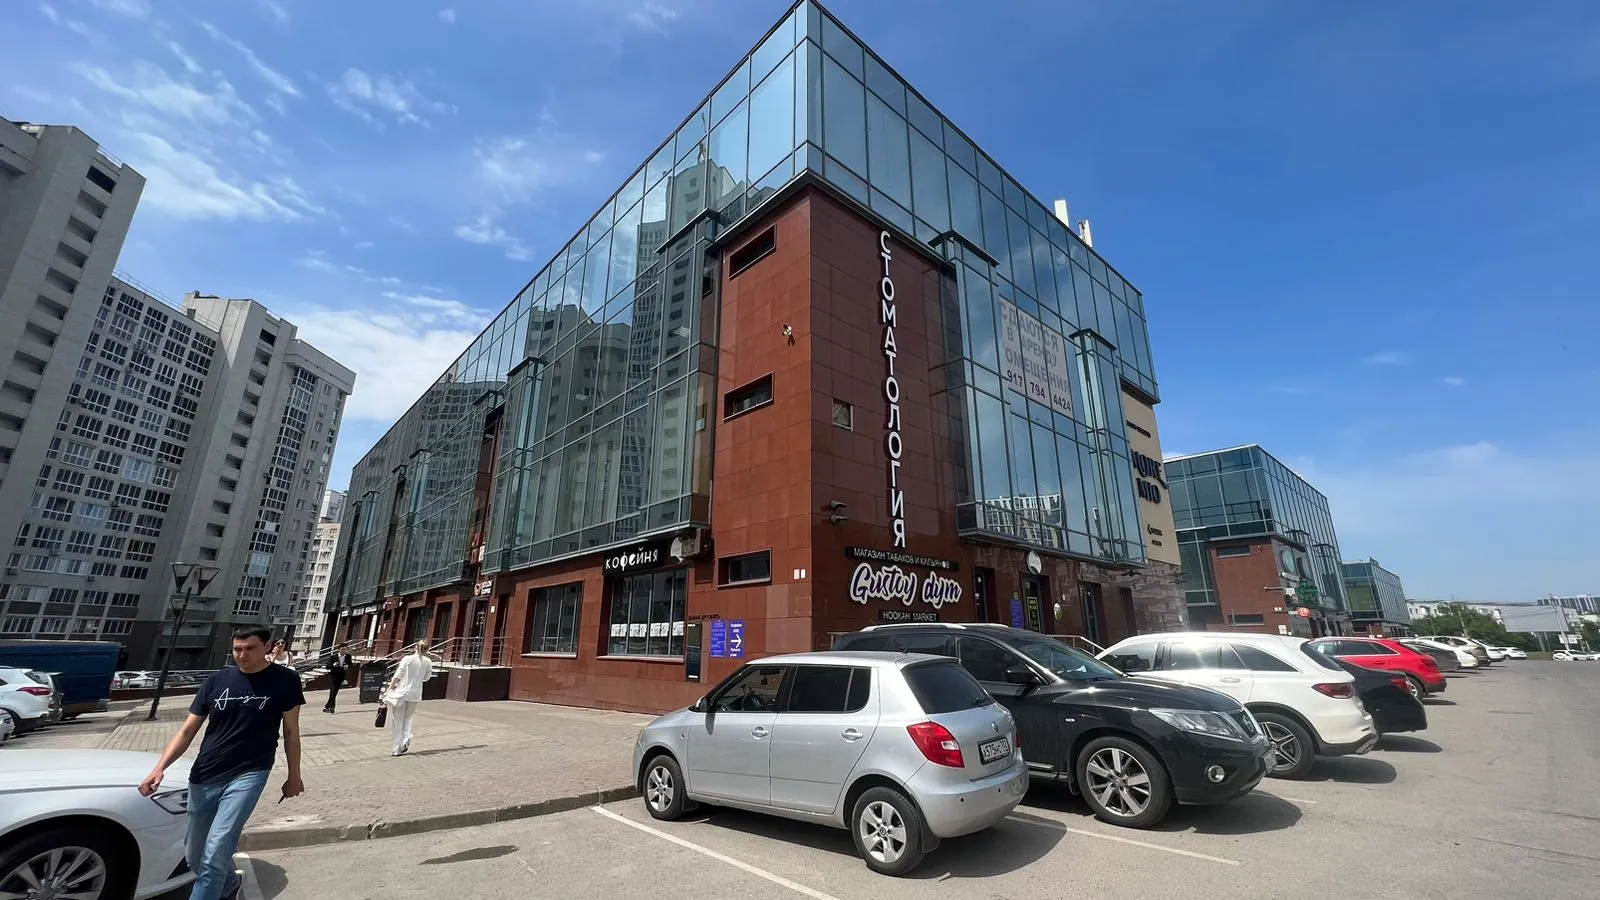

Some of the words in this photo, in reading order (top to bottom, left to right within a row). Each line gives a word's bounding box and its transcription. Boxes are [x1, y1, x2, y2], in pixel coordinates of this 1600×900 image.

[1007, 327, 1014, 342] В
[880, 230, 905, 548] СТОМАТОЛОГИЯ
[1006, 370, 1023, 388] 917
[1030, 382, 1046, 400] 794
[1053, 394, 1071, 412] 4424
[853, 548, 886, 560] МАГАЗИН
[886, 552, 914, 564] ТАБАКОВ
[850, 562, 917, 606] Gustoy
[922, 570, 962, 609] dym
[913, 612, 937, 622] MARKET
